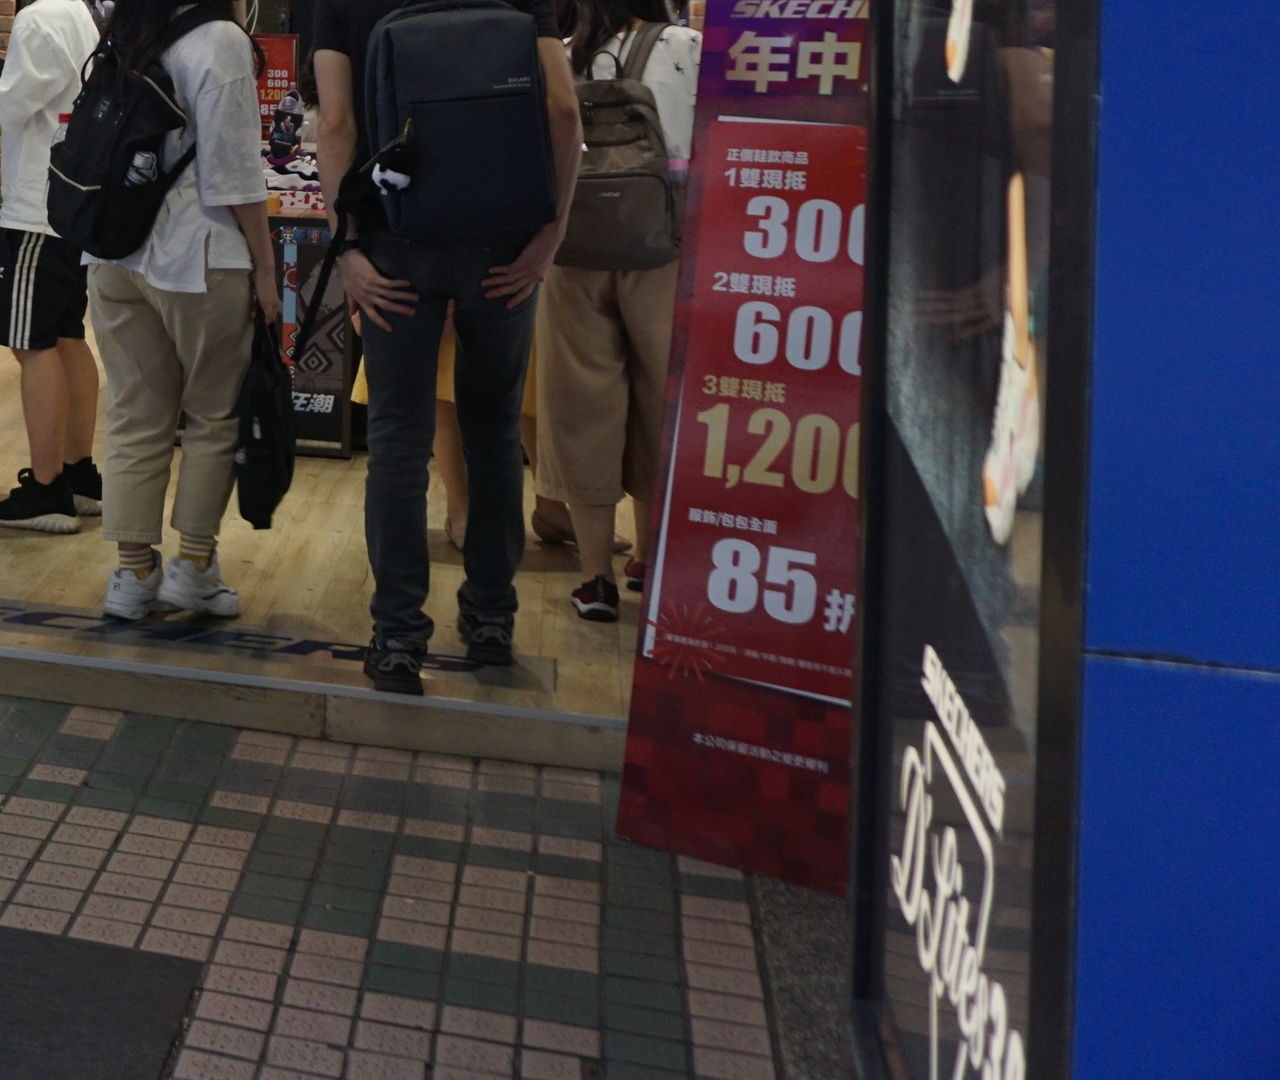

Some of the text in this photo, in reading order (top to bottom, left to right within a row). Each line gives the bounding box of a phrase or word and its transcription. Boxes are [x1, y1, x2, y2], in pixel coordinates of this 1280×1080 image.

[729, 0, 870, 19] SKECH
[268, 69, 288, 78] 300
[268, 79, 288, 88] 600
[725, 30, 863, 95] 年中
[706, 537, 817, 625] 85
[920, 643, 1006, 835] SKECHERS
